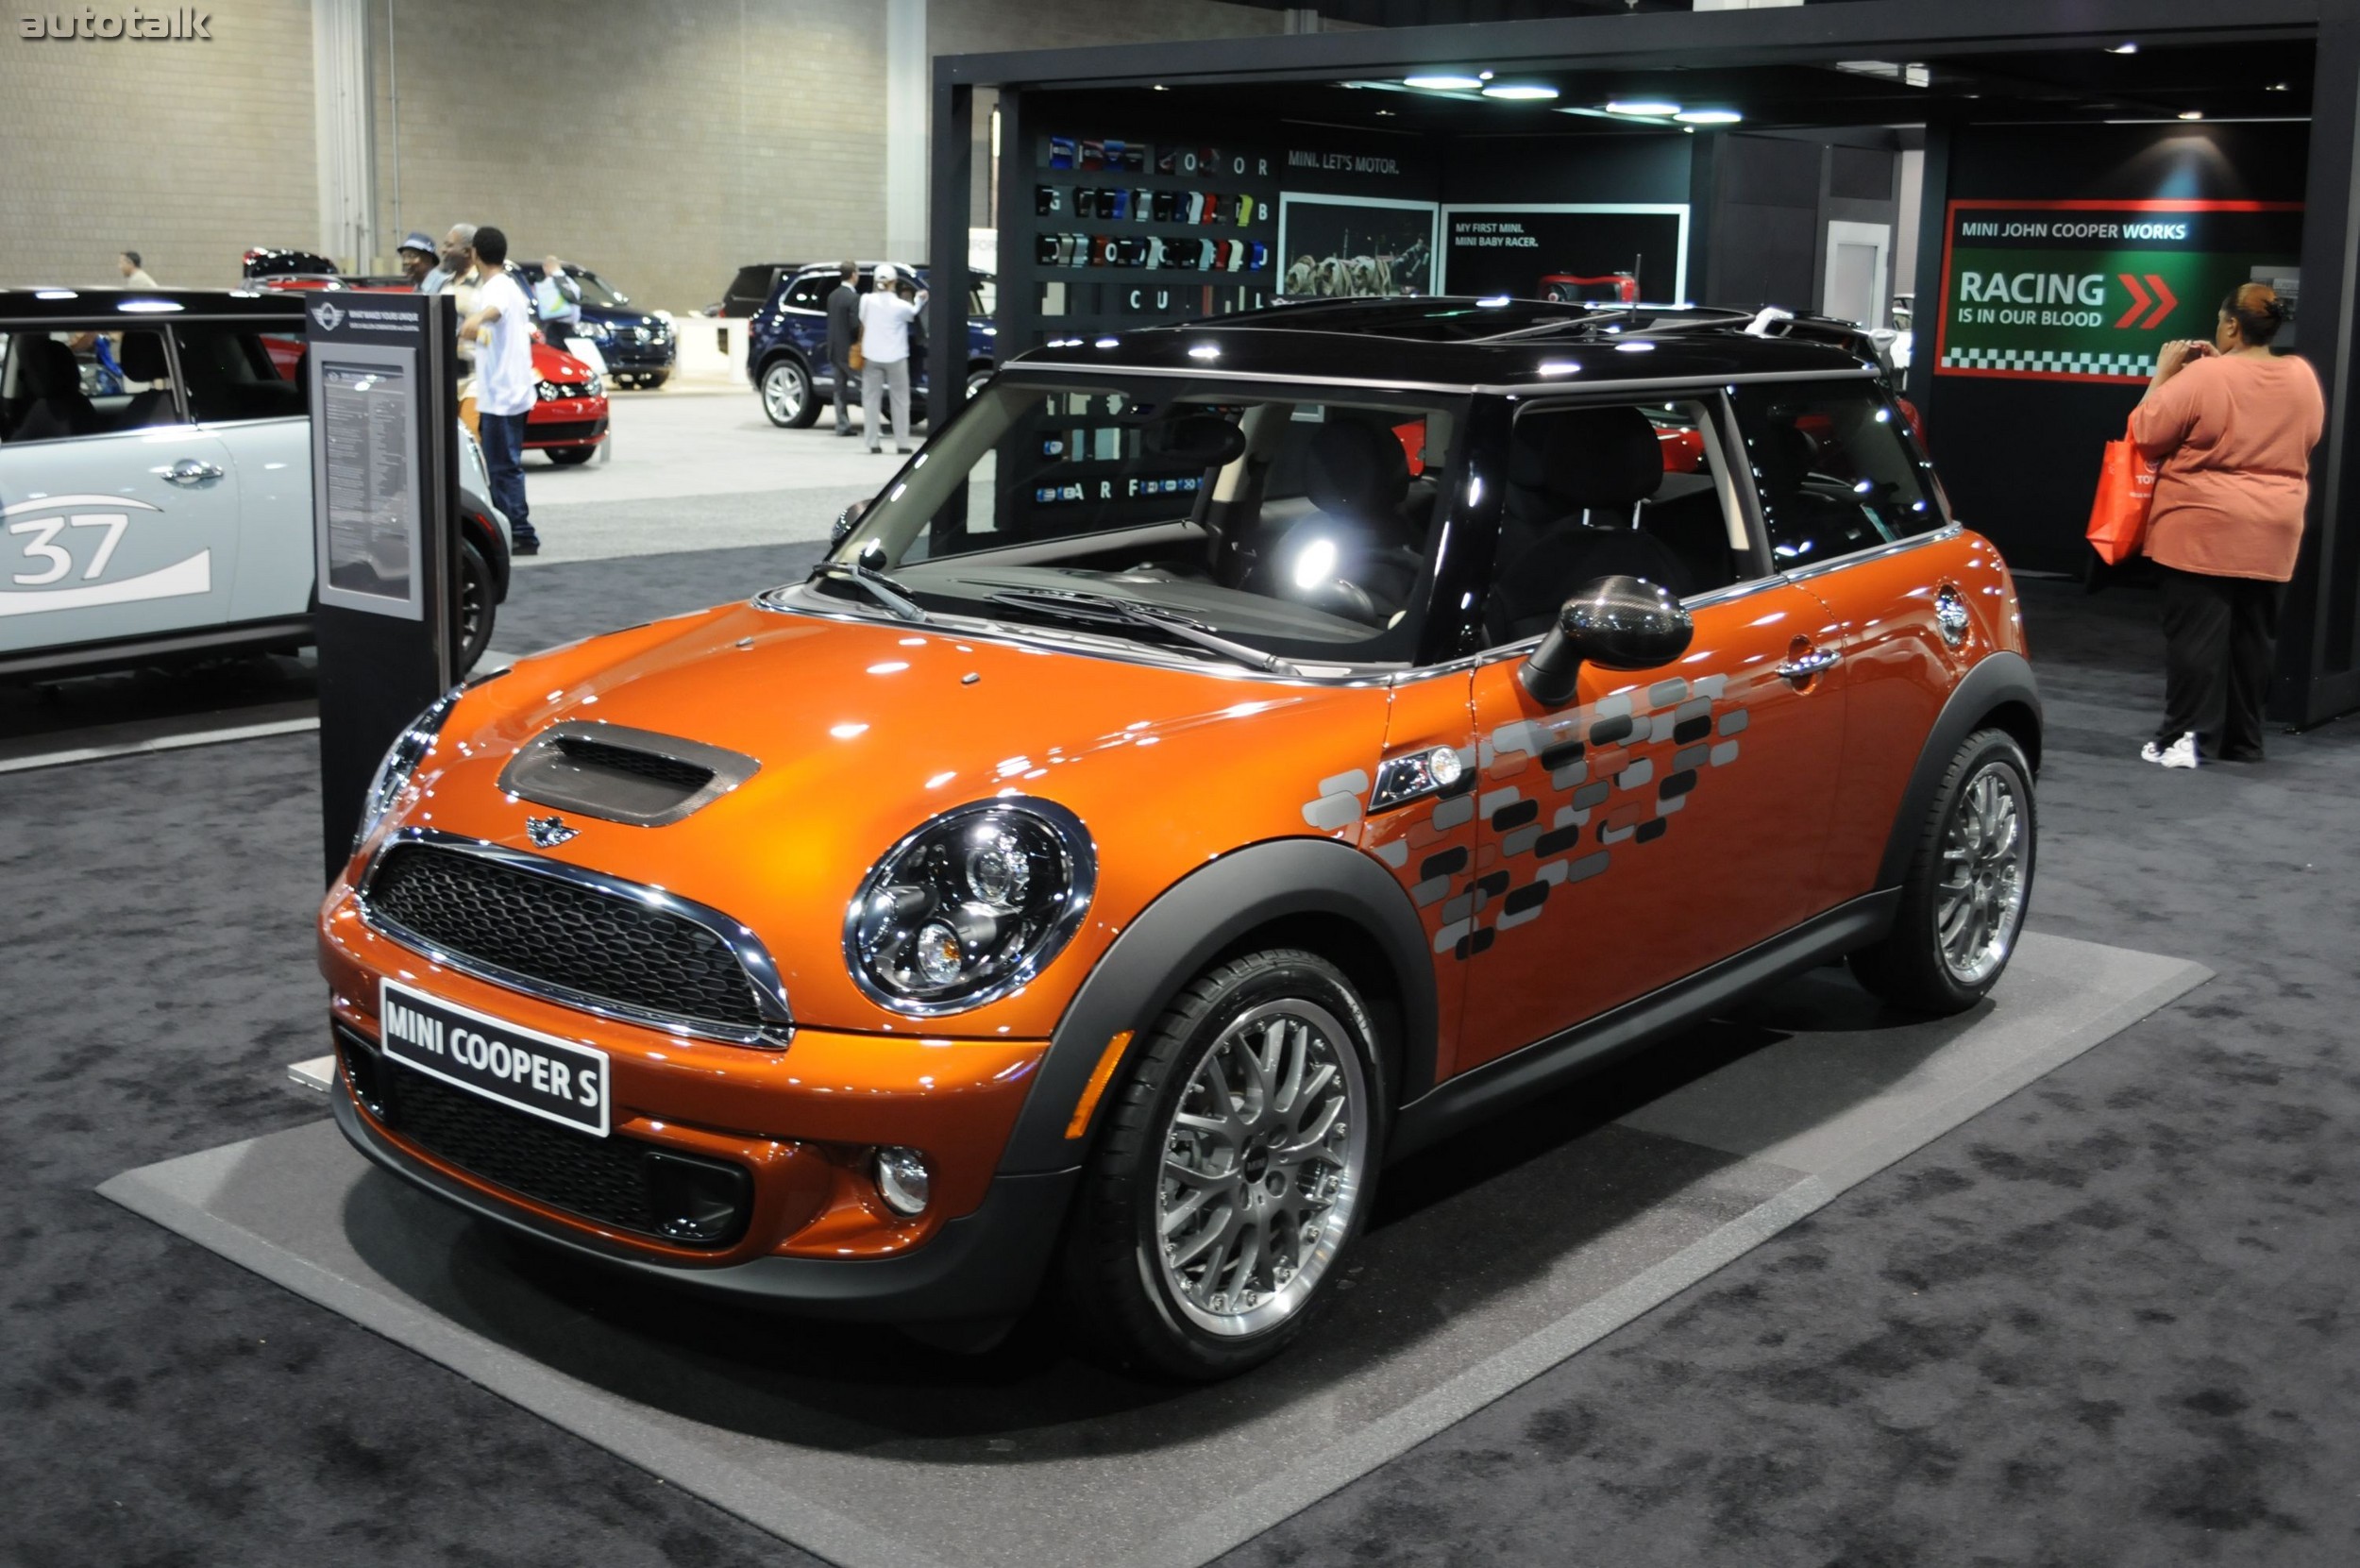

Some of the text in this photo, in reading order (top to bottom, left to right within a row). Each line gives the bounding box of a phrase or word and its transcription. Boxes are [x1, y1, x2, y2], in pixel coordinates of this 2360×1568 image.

[1289, 150, 1399, 175] MINI. LET'S MOTOR.
[1456, 223, 1471, 233] MY
[1473, 223, 1497, 234] FIRST
[1962, 222, 2186, 240] MINI JOHN COOPER WORKS
[1455, 236, 1539, 248] MINI BABY RACER.
[1960, 272, 2105, 306] RACING
[1958, 308, 2102, 328] IS IN OUR BLOOD
[9, 514, 128, 586] 37
[387, 1000, 599, 1107] MINI COOPER S
